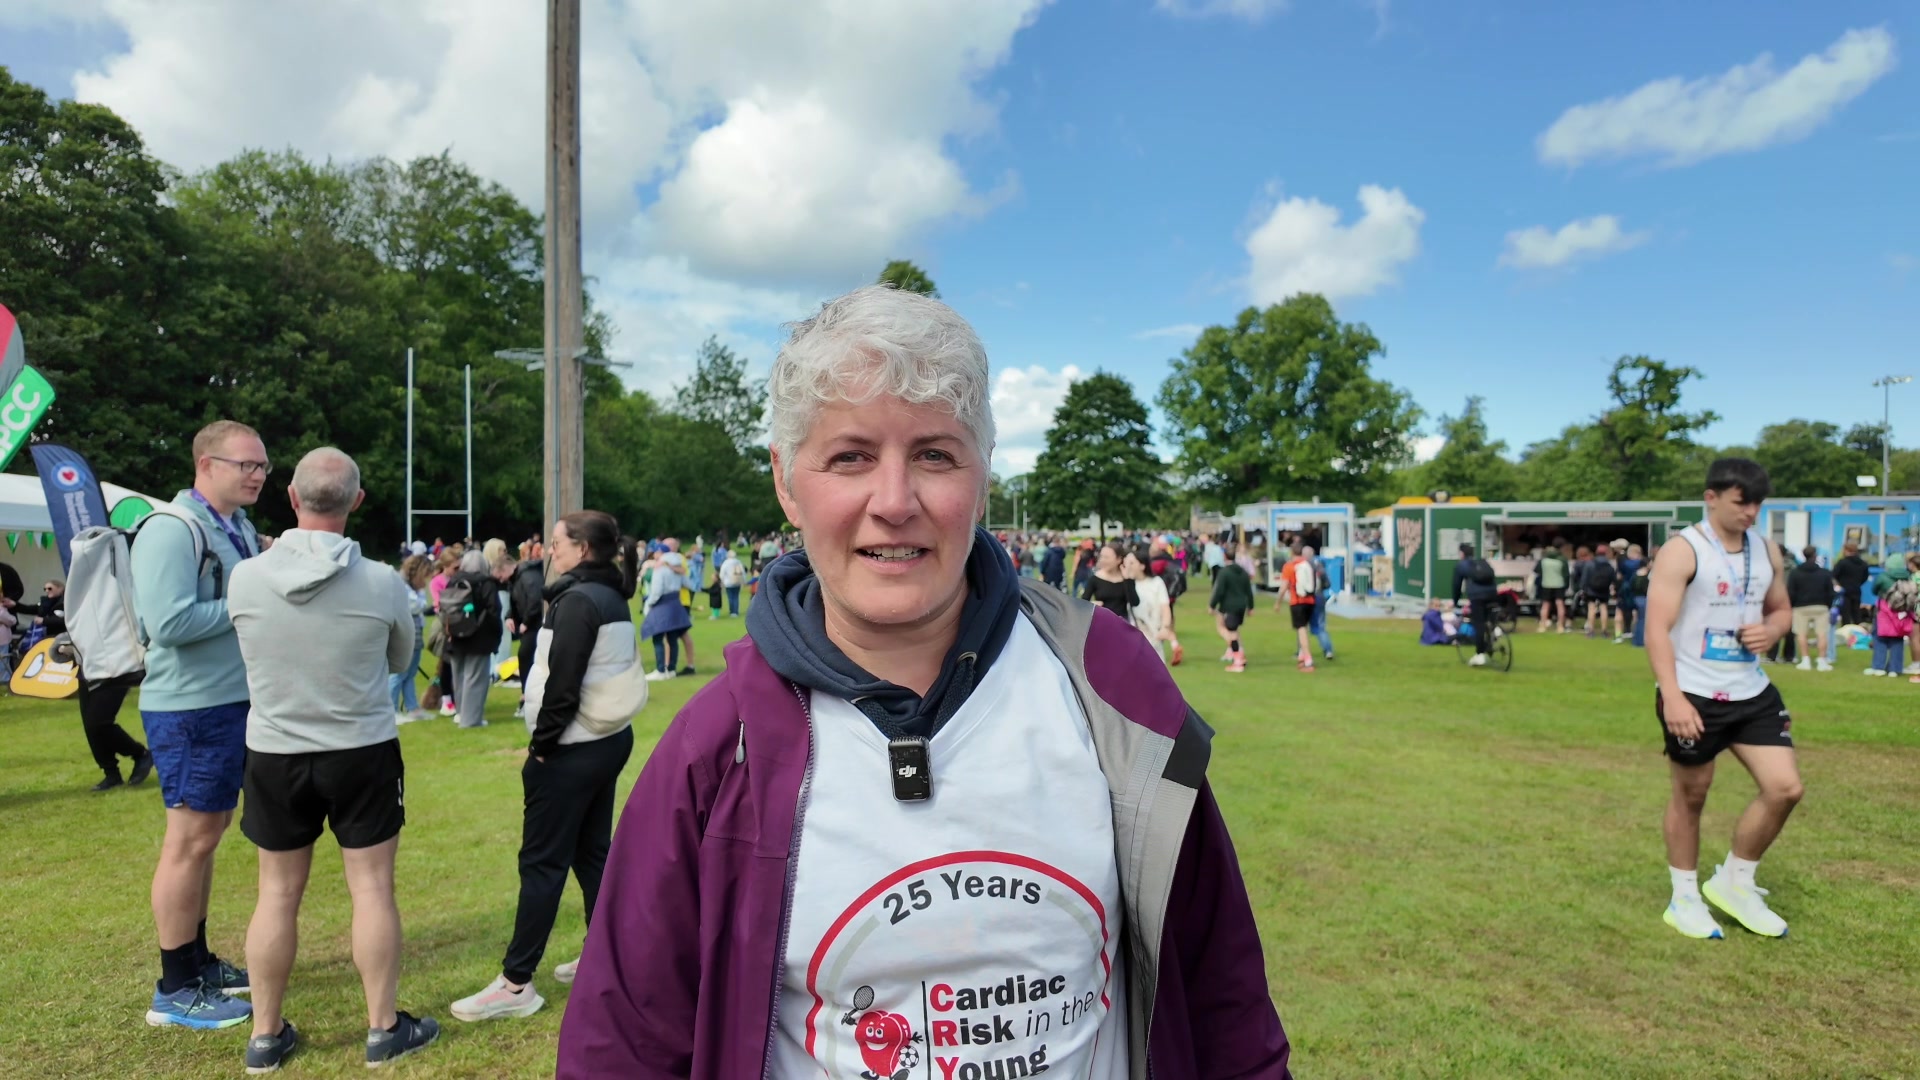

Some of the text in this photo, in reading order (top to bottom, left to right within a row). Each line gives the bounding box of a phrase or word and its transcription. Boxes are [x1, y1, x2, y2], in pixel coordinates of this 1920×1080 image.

[0, 382, 41, 462] PCC
[883, 869, 1042, 926] 25 Years
[929, 974, 1066, 1013] Cardiac
[931, 990, 1095, 1047] Risk in the
[934, 1044, 1050, 1080] Young
